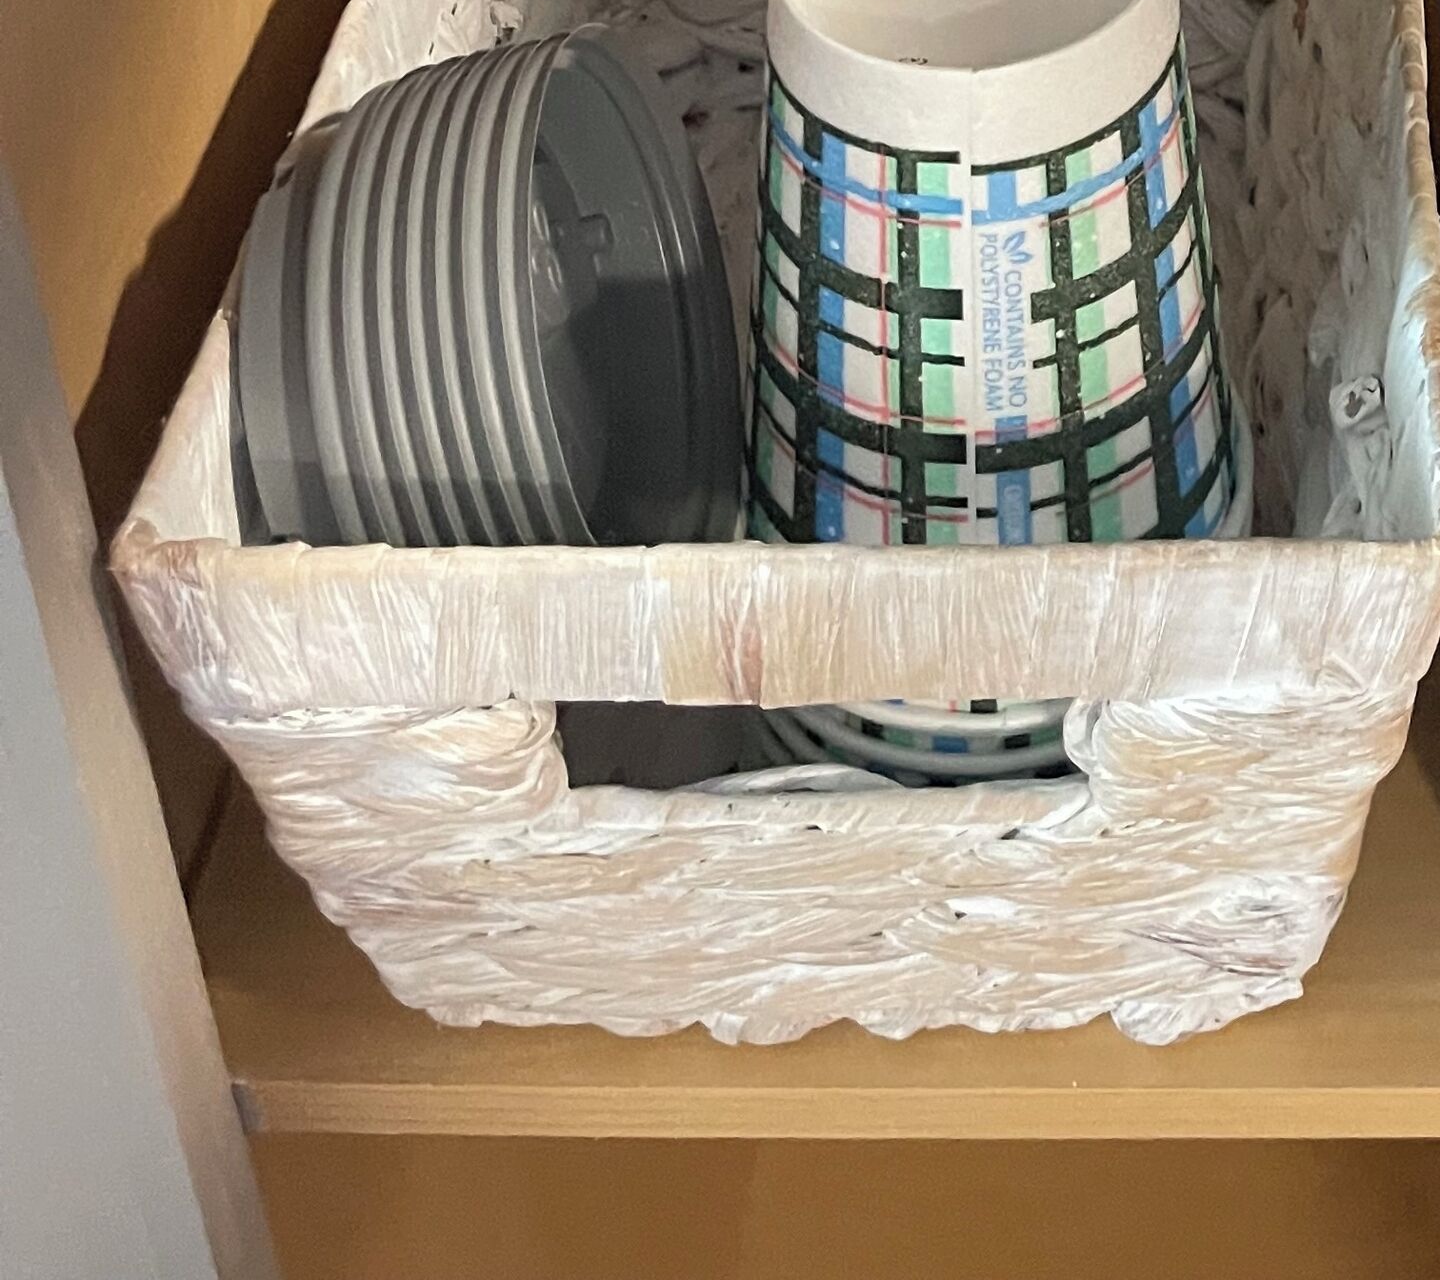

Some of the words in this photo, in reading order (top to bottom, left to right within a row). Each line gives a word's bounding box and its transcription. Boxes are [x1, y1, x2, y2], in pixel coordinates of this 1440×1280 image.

[979, 233, 1002, 355] POLYSTYRENE
[1003, 269, 1026, 372] CONTAINS
[983, 358, 1004, 412] FOAM
[1007, 375, 1028, 408] NO
